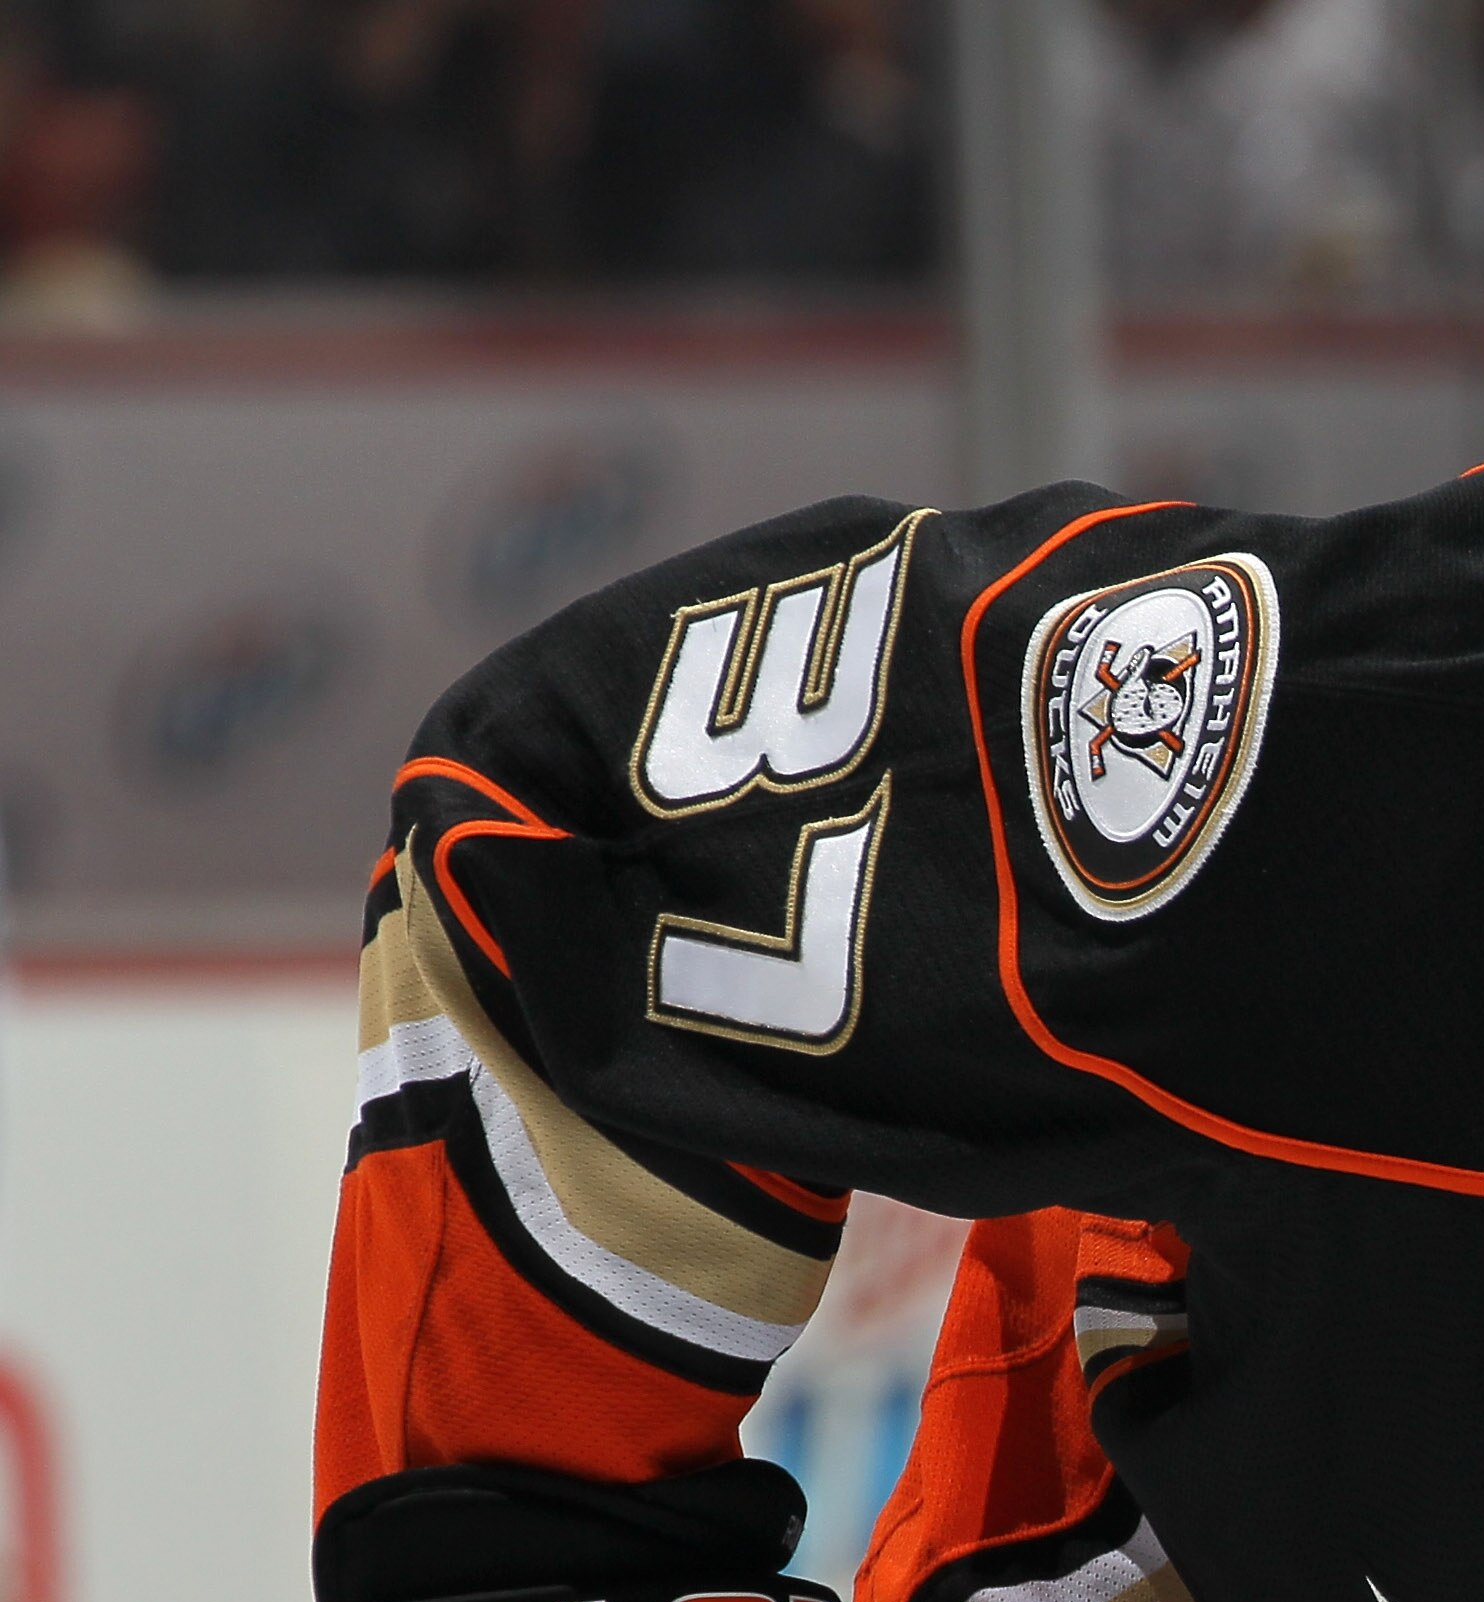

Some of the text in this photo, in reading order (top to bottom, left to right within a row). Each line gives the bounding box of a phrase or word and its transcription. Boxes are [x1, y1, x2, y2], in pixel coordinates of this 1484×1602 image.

[631, 509, 930, 1056] 37
[1048, 603, 1107, 821] DUCKS
[1152, 575, 1242, 848] ANAHEIM
